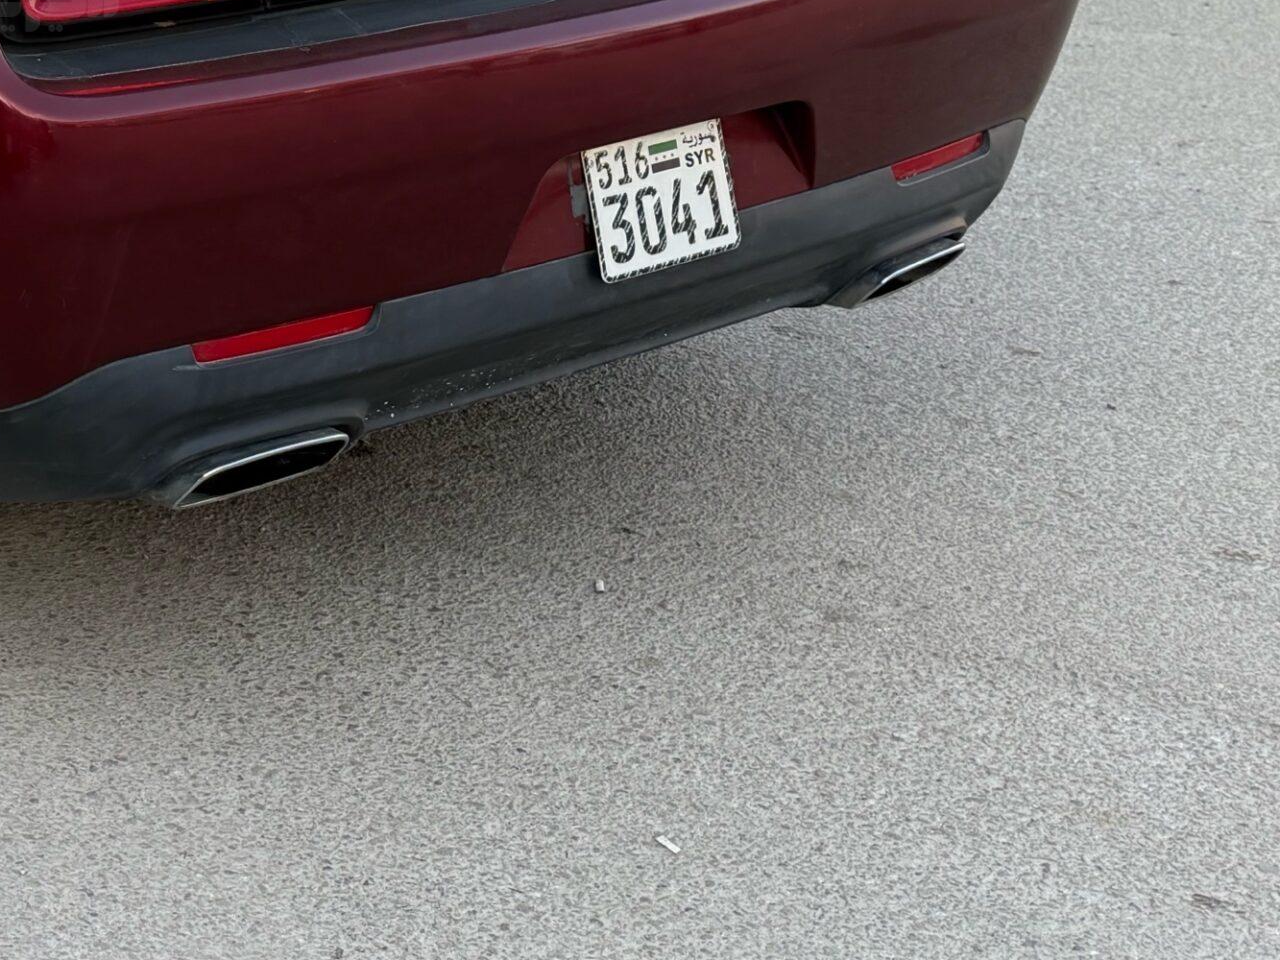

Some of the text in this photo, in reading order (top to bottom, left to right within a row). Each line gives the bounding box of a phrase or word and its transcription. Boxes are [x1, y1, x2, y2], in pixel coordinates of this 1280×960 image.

[594, 141, 650, 189] 516
[685, 148, 716, 167] SYR
[602, 170, 729, 264] 3041
